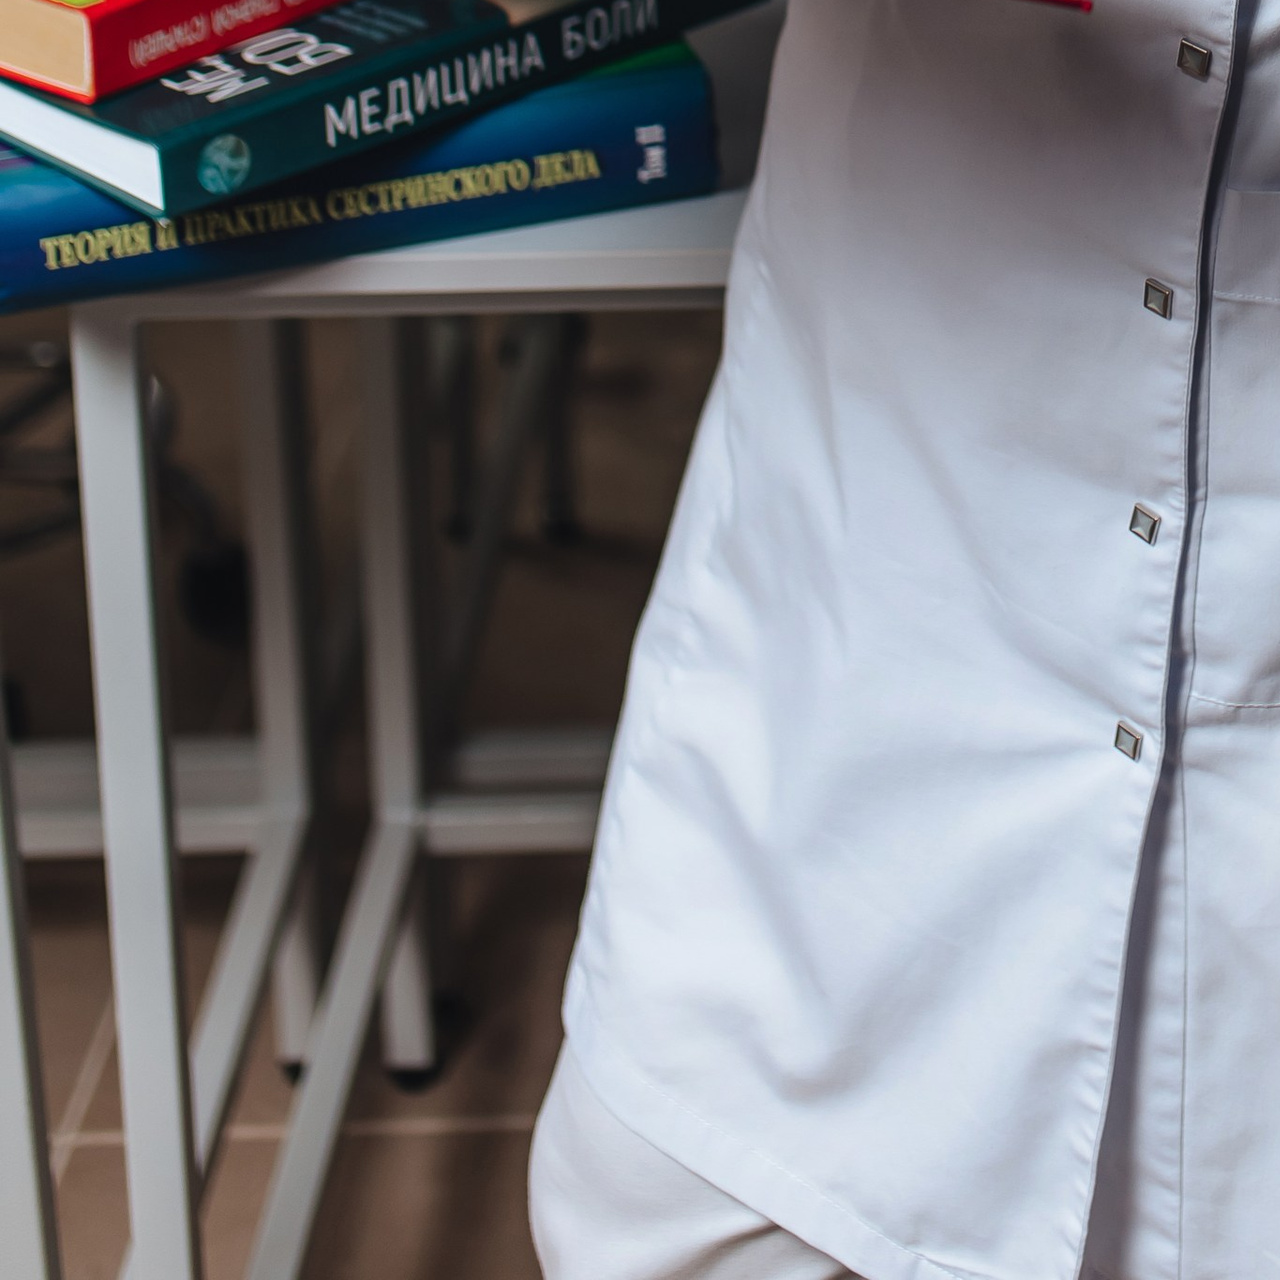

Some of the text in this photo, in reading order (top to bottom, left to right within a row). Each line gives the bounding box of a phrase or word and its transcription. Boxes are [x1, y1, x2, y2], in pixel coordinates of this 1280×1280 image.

[324, 32, 546, 148] МЕДИЦИНА
[39, 148, 602, 270] ТЕОРИЯ И ПРАКТИКА СЕСТРИНСКОГО ДЕЛА
